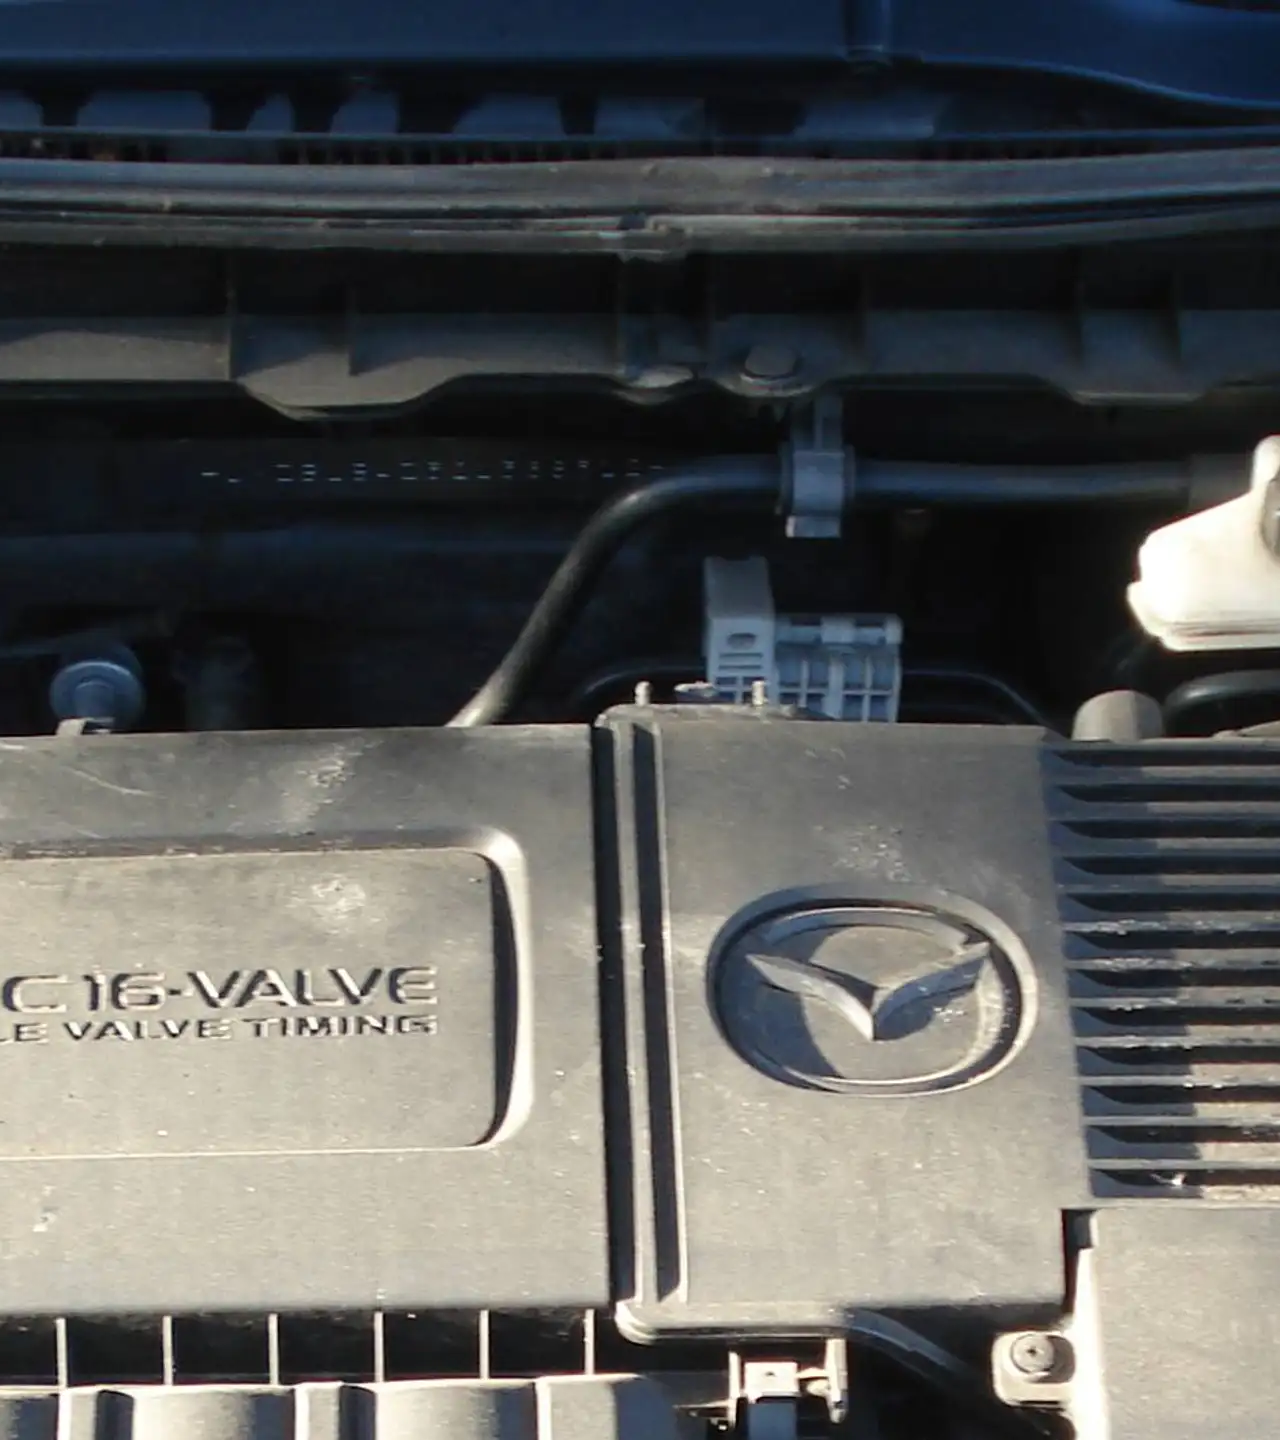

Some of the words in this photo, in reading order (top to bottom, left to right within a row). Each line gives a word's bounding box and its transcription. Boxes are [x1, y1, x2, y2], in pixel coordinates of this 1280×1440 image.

[83, 965, 437, 1011] 16-VALVE
[63, 1017, 232, 1042] VALVE
[241, 1013, 437, 1038] TIMING
